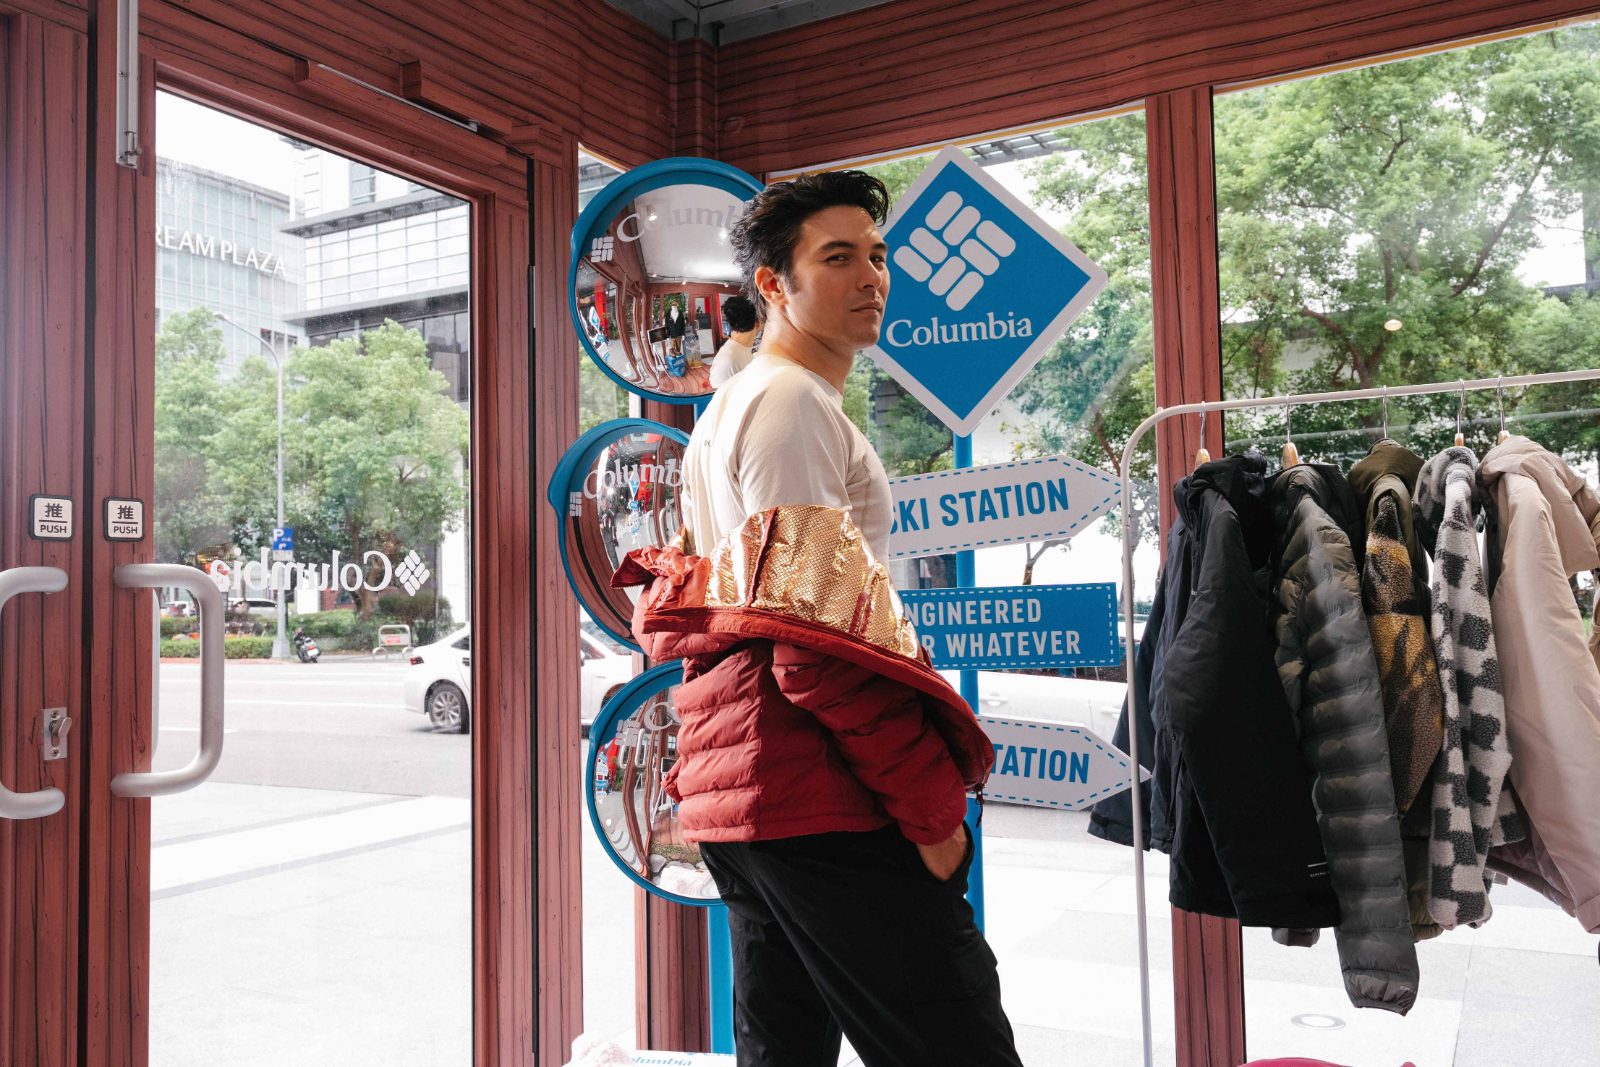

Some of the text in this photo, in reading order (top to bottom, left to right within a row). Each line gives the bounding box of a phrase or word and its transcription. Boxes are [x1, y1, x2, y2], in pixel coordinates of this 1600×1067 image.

[617, 205, 741, 242] Columb
[156, 223, 286, 276] REAM PLAZA
[886, 311, 1032, 347] Columbia
[583, 458, 683, 499] Columb
[45, 503, 62, 518] 推
[117, 505, 134, 520] 推
[939, 478, 1069, 527] STATION
[40, 525, 67, 533] PUSH
[113, 526, 138, 534] PUSH
[904, 598, 1042, 627] NGINEERED
[946, 630, 1082, 658] WHATEVER
[991, 743, 1089, 785] TATION
[632, 1056, 692, 1067] lumbia
